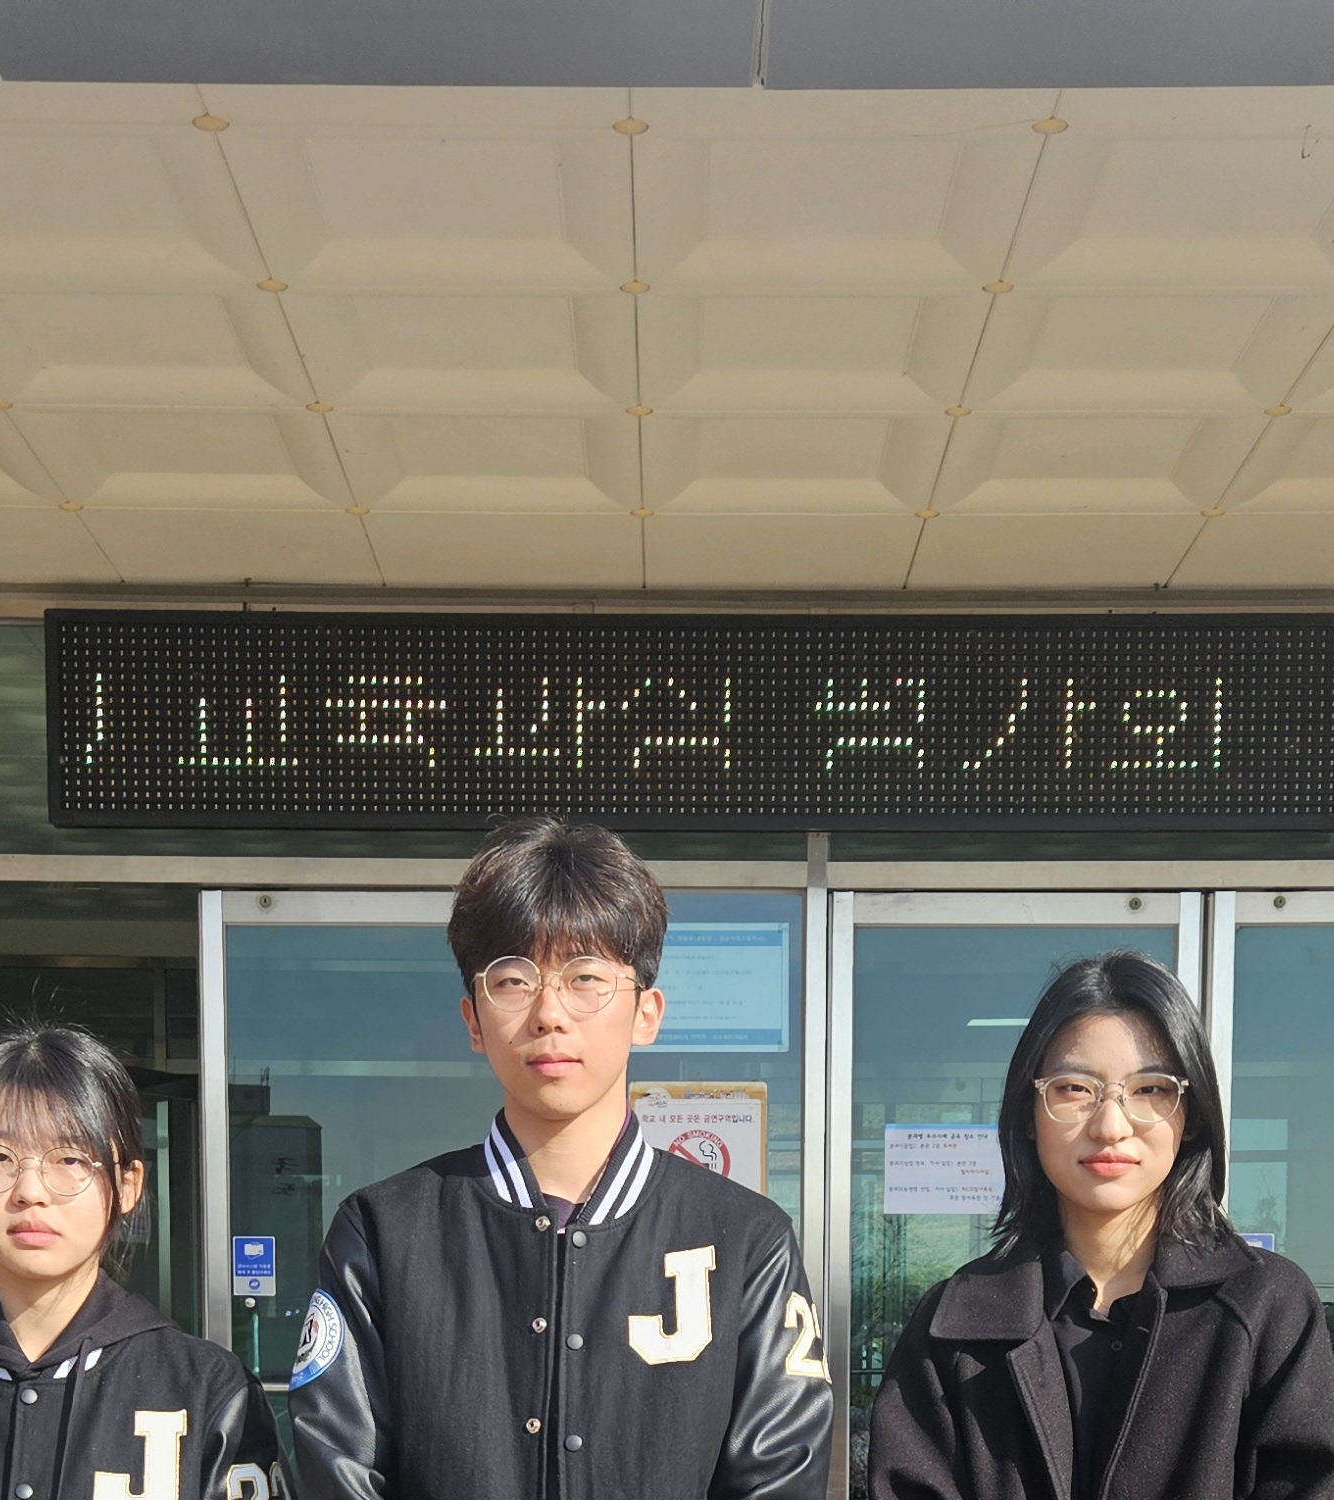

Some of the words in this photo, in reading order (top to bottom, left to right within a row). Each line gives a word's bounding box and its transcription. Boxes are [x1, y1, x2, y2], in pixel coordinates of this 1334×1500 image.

[673, 1135, 686, 1146] NO
[687, 1130, 724, 1149] SMOKING
[628, 1244, 716, 1366] J
[318, 1323, 338, 1361] SCHOOL
